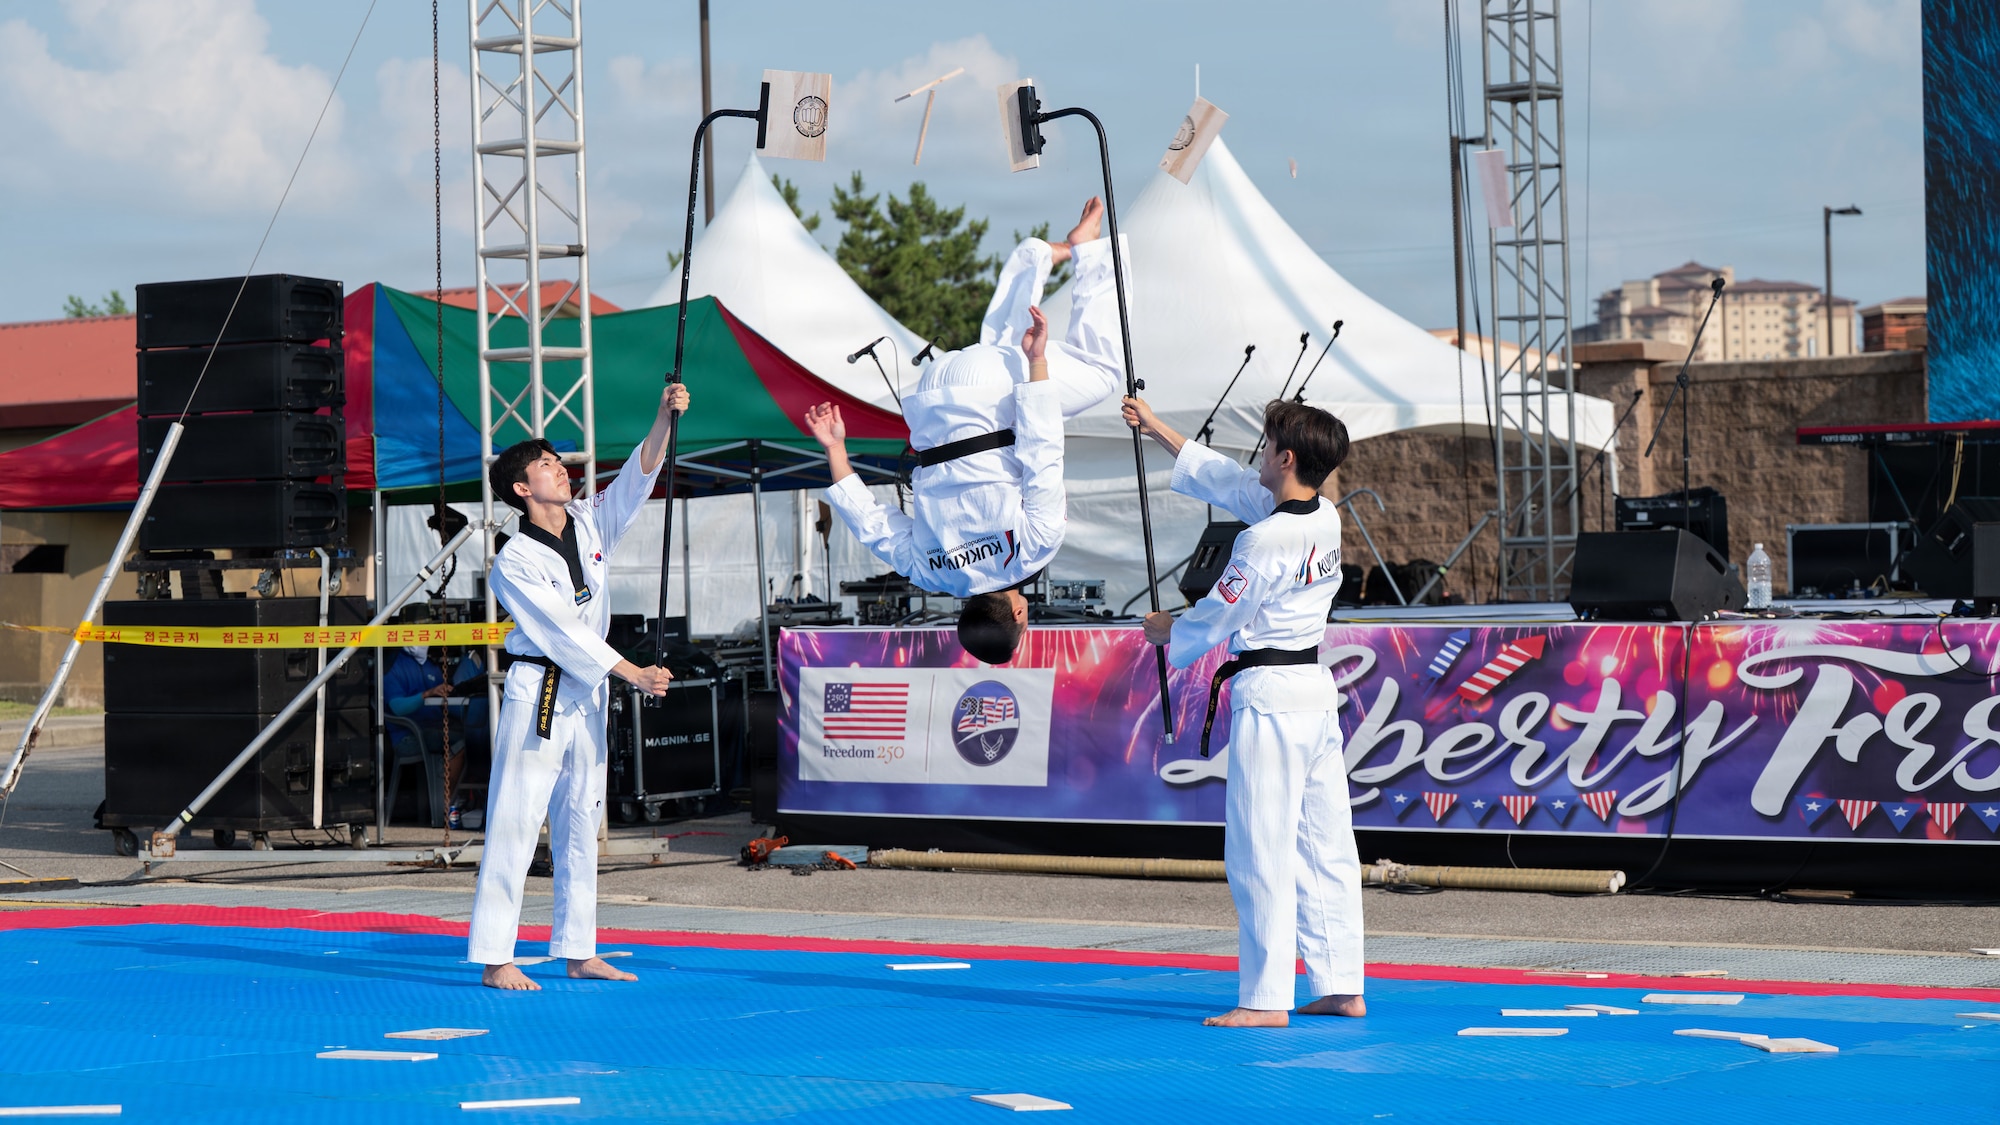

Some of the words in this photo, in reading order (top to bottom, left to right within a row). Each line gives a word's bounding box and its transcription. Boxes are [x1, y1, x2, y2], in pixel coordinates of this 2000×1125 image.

[73, 630, 121, 641] 근금지
[143, 631, 199, 644] 접근금지
[222, 631, 279, 644] 접근금지
[303, 631, 362, 644] 접근금지
[386, 629, 447, 642] 접근금지
[471, 627, 514, 641] 접근
[831, 694, 845, 704] 250
[957, 696, 1015, 733] 250
[645, 732, 711, 748] MAGNIMGE
[823, 745, 875, 759] Freedom
[877, 745, 905, 765] 250
